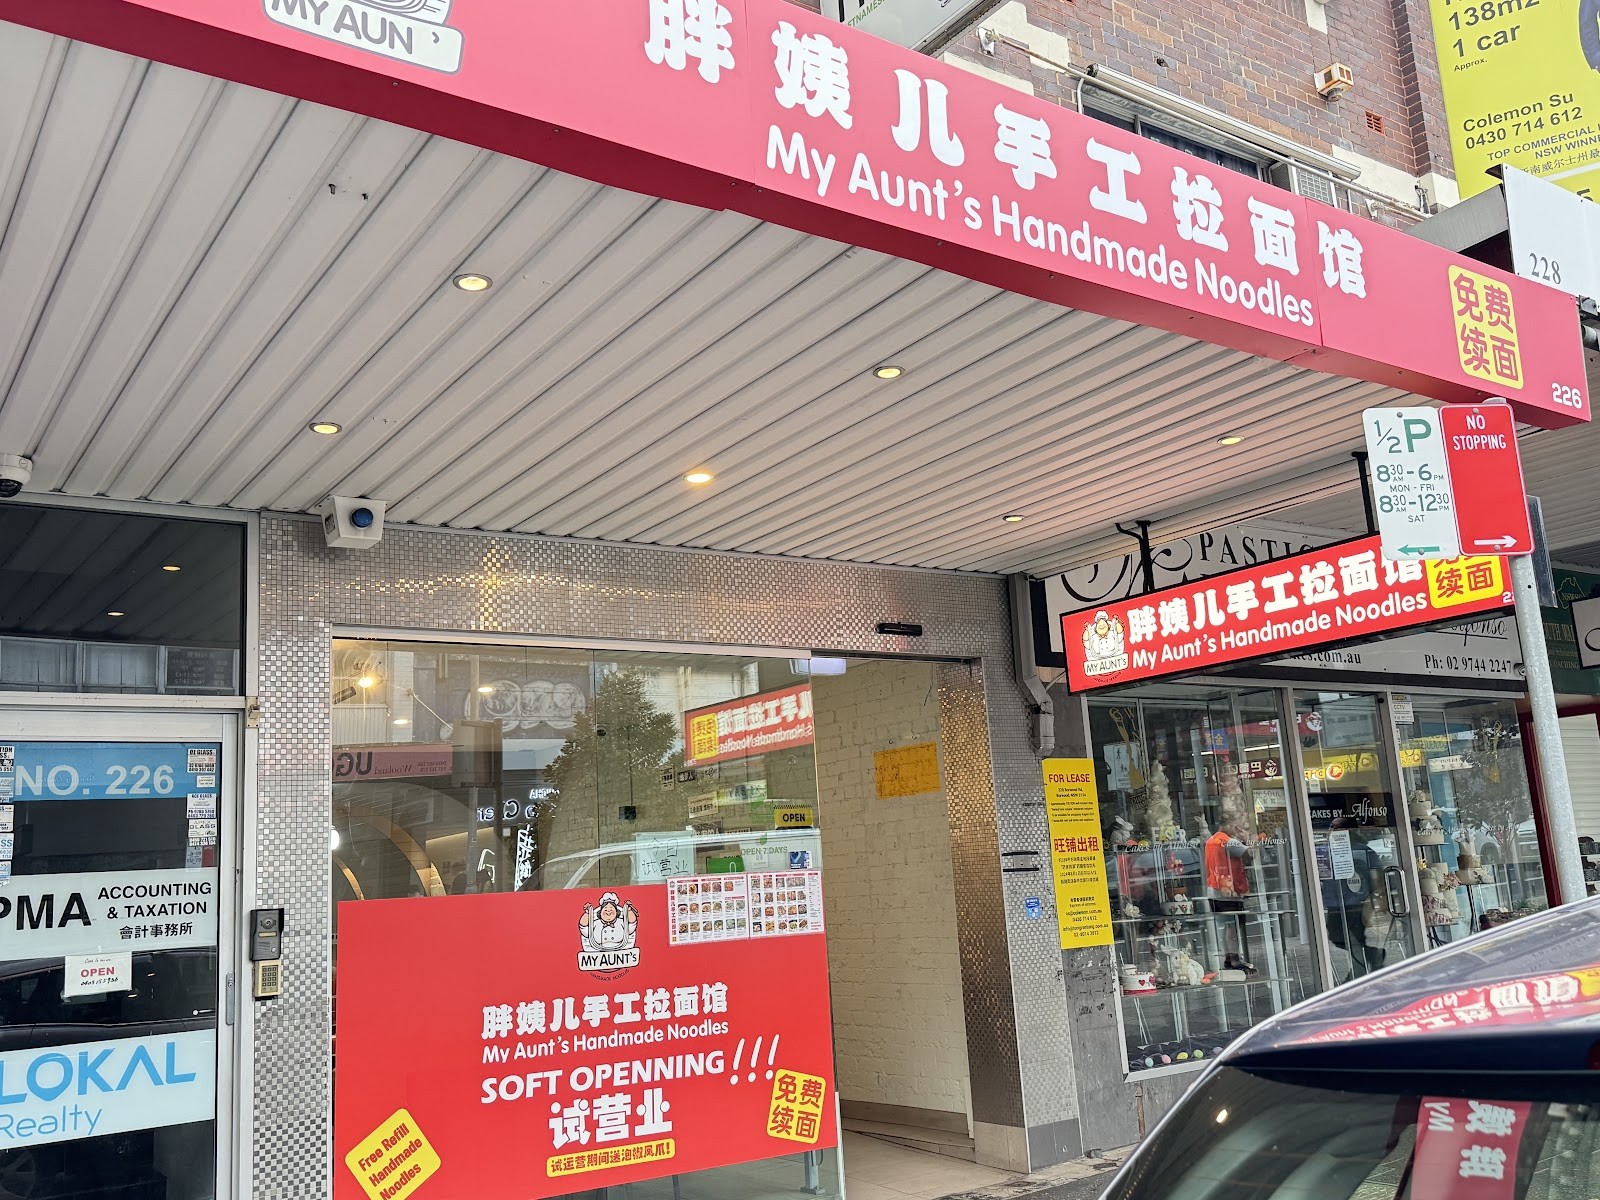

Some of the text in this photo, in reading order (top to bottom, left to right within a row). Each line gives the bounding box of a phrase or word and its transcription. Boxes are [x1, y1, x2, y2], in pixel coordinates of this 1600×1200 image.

[1453, 24, 1521, 58] 1 car
[1453, 58, 1488, 72] Approx.
[1463, 93, 1574, 132] Colemon Su
[1465, 106, 1582, 150] 0430 714 612
[643, 0, 1367, 299] 胖姨儿手工拉面馆
[1487, 125, 1595, 161] TOP COMMERCIAL
[1535, 145, 1562, 159] NSW
[766, 124, 1314, 327] My Aunt's Handmade Noodles
[1529, 252, 1561, 284] 228
[1453, 273, 1514, 334] 免费
[1460, 323, 1519, 381] 续面
[1551, 382, 1582, 409] 226
[1466, 415, 1485, 430] NO
[1453, 434, 1507, 450] STOPPING
[1390, 484, 1410, 493] MON
[1420, 484, 1435, 492] FRI
[1408, 515, 1425, 523] SAT
[1435, 560, 1494, 598] 续面
[1132, 592, 1428, 671] My Aunt's Handmade Noodles
[1086, 663, 1098, 673] MY
[1424, 654, 1443, 669] Ph:
[1446, 656, 1458, 670] 02
[1462, 657, 1486, 671] 9744
[1489, 659, 1511, 673] 2247
[15, 765, 174, 796] NO. 226
[1048, 773, 1091, 783] FOR LEASE
[782, 813, 806, 823] OPEN
[1351, 798, 1388, 824] Alfonso
[1257, 837, 1288, 847] Alfonso
[98, 882, 212, 900] ACCOUNTING
[107, 901, 207, 919] & TAXATION
[119, 922, 193, 940] 會計事務所
[80, 966, 115, 978] OPEN
[581, 955, 598, 967] MY
[481, 982, 729, 1040] 胖姨儿手工拉面馆
[482, 1020, 729, 1064] My Aunt's Handmade Noodles
[0, 1042, 196, 1105] LOKAL
[481, 1069, 563, 1104] SOFT
[569, 1050, 725, 1092] OPENNING
[774, 1073, 823, 1109] 免费
[0, 1104, 103, 1139] Realty
[549, 1087, 674, 1149] 试营业
[770, 1105, 818, 1139] 续面
[358, 1122, 410, 1172] Free Refill
[368, 1138, 423, 1187] Handmade
[379, 1163, 422, 1200] Noodles
